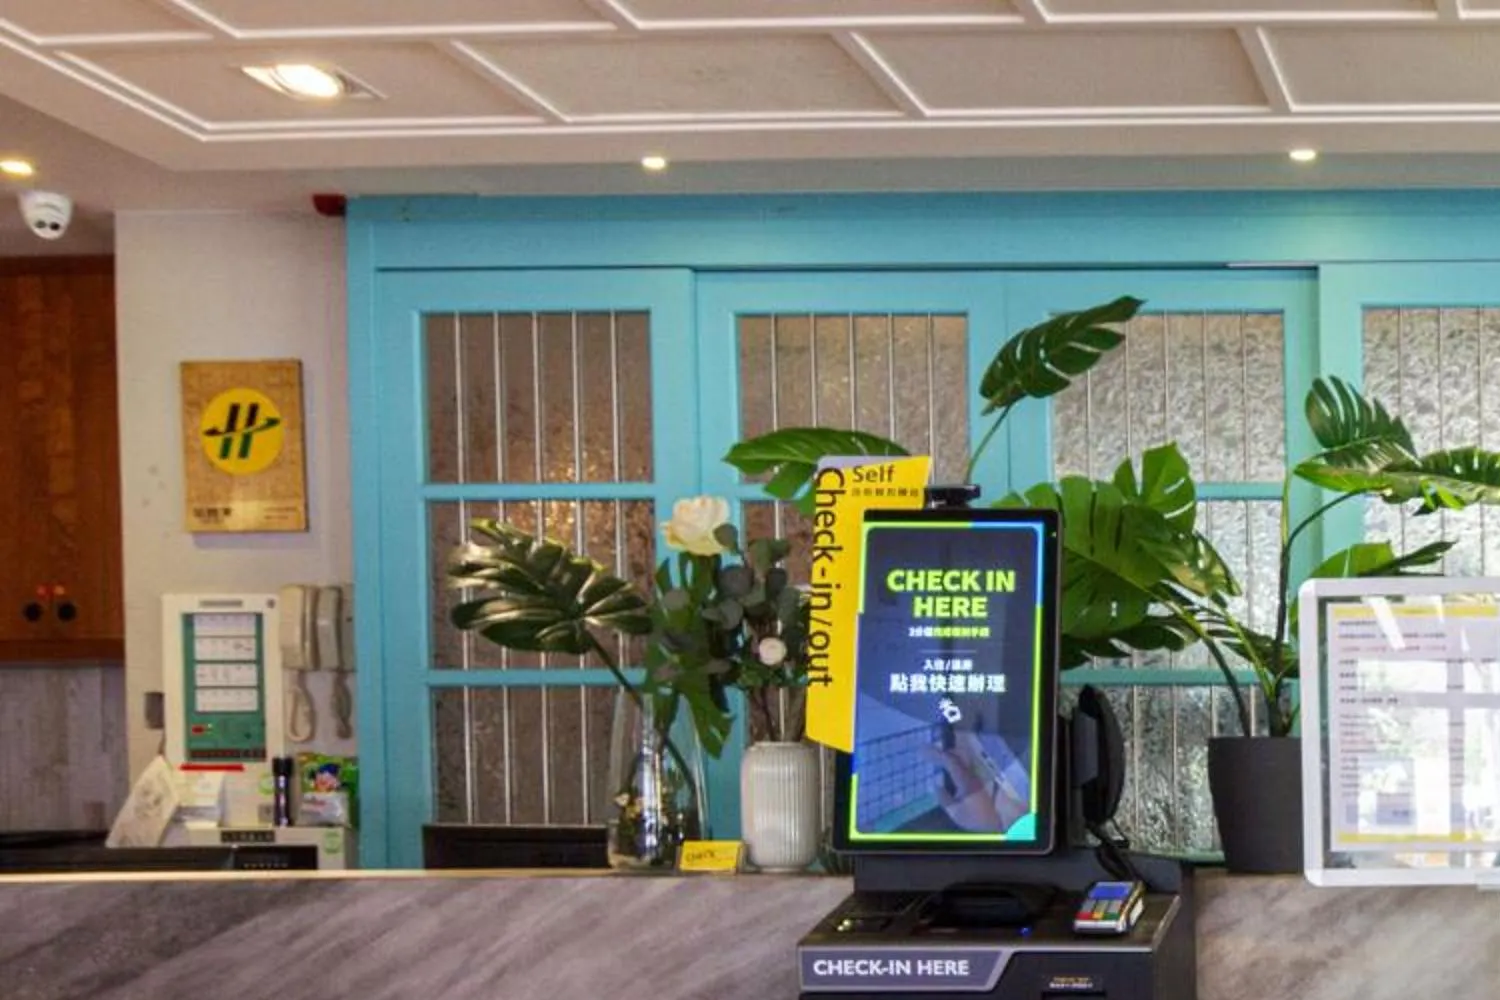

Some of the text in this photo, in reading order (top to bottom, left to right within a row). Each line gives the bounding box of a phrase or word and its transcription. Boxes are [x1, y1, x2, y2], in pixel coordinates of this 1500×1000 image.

[851, 464, 895, 484] Self
[806, 467, 847, 687] Check-in/out
[886, 569, 1016, 592] CHECK IN
[913, 596, 988, 618] HERE
[813, 959, 970, 976] CHECK-IN HERE
